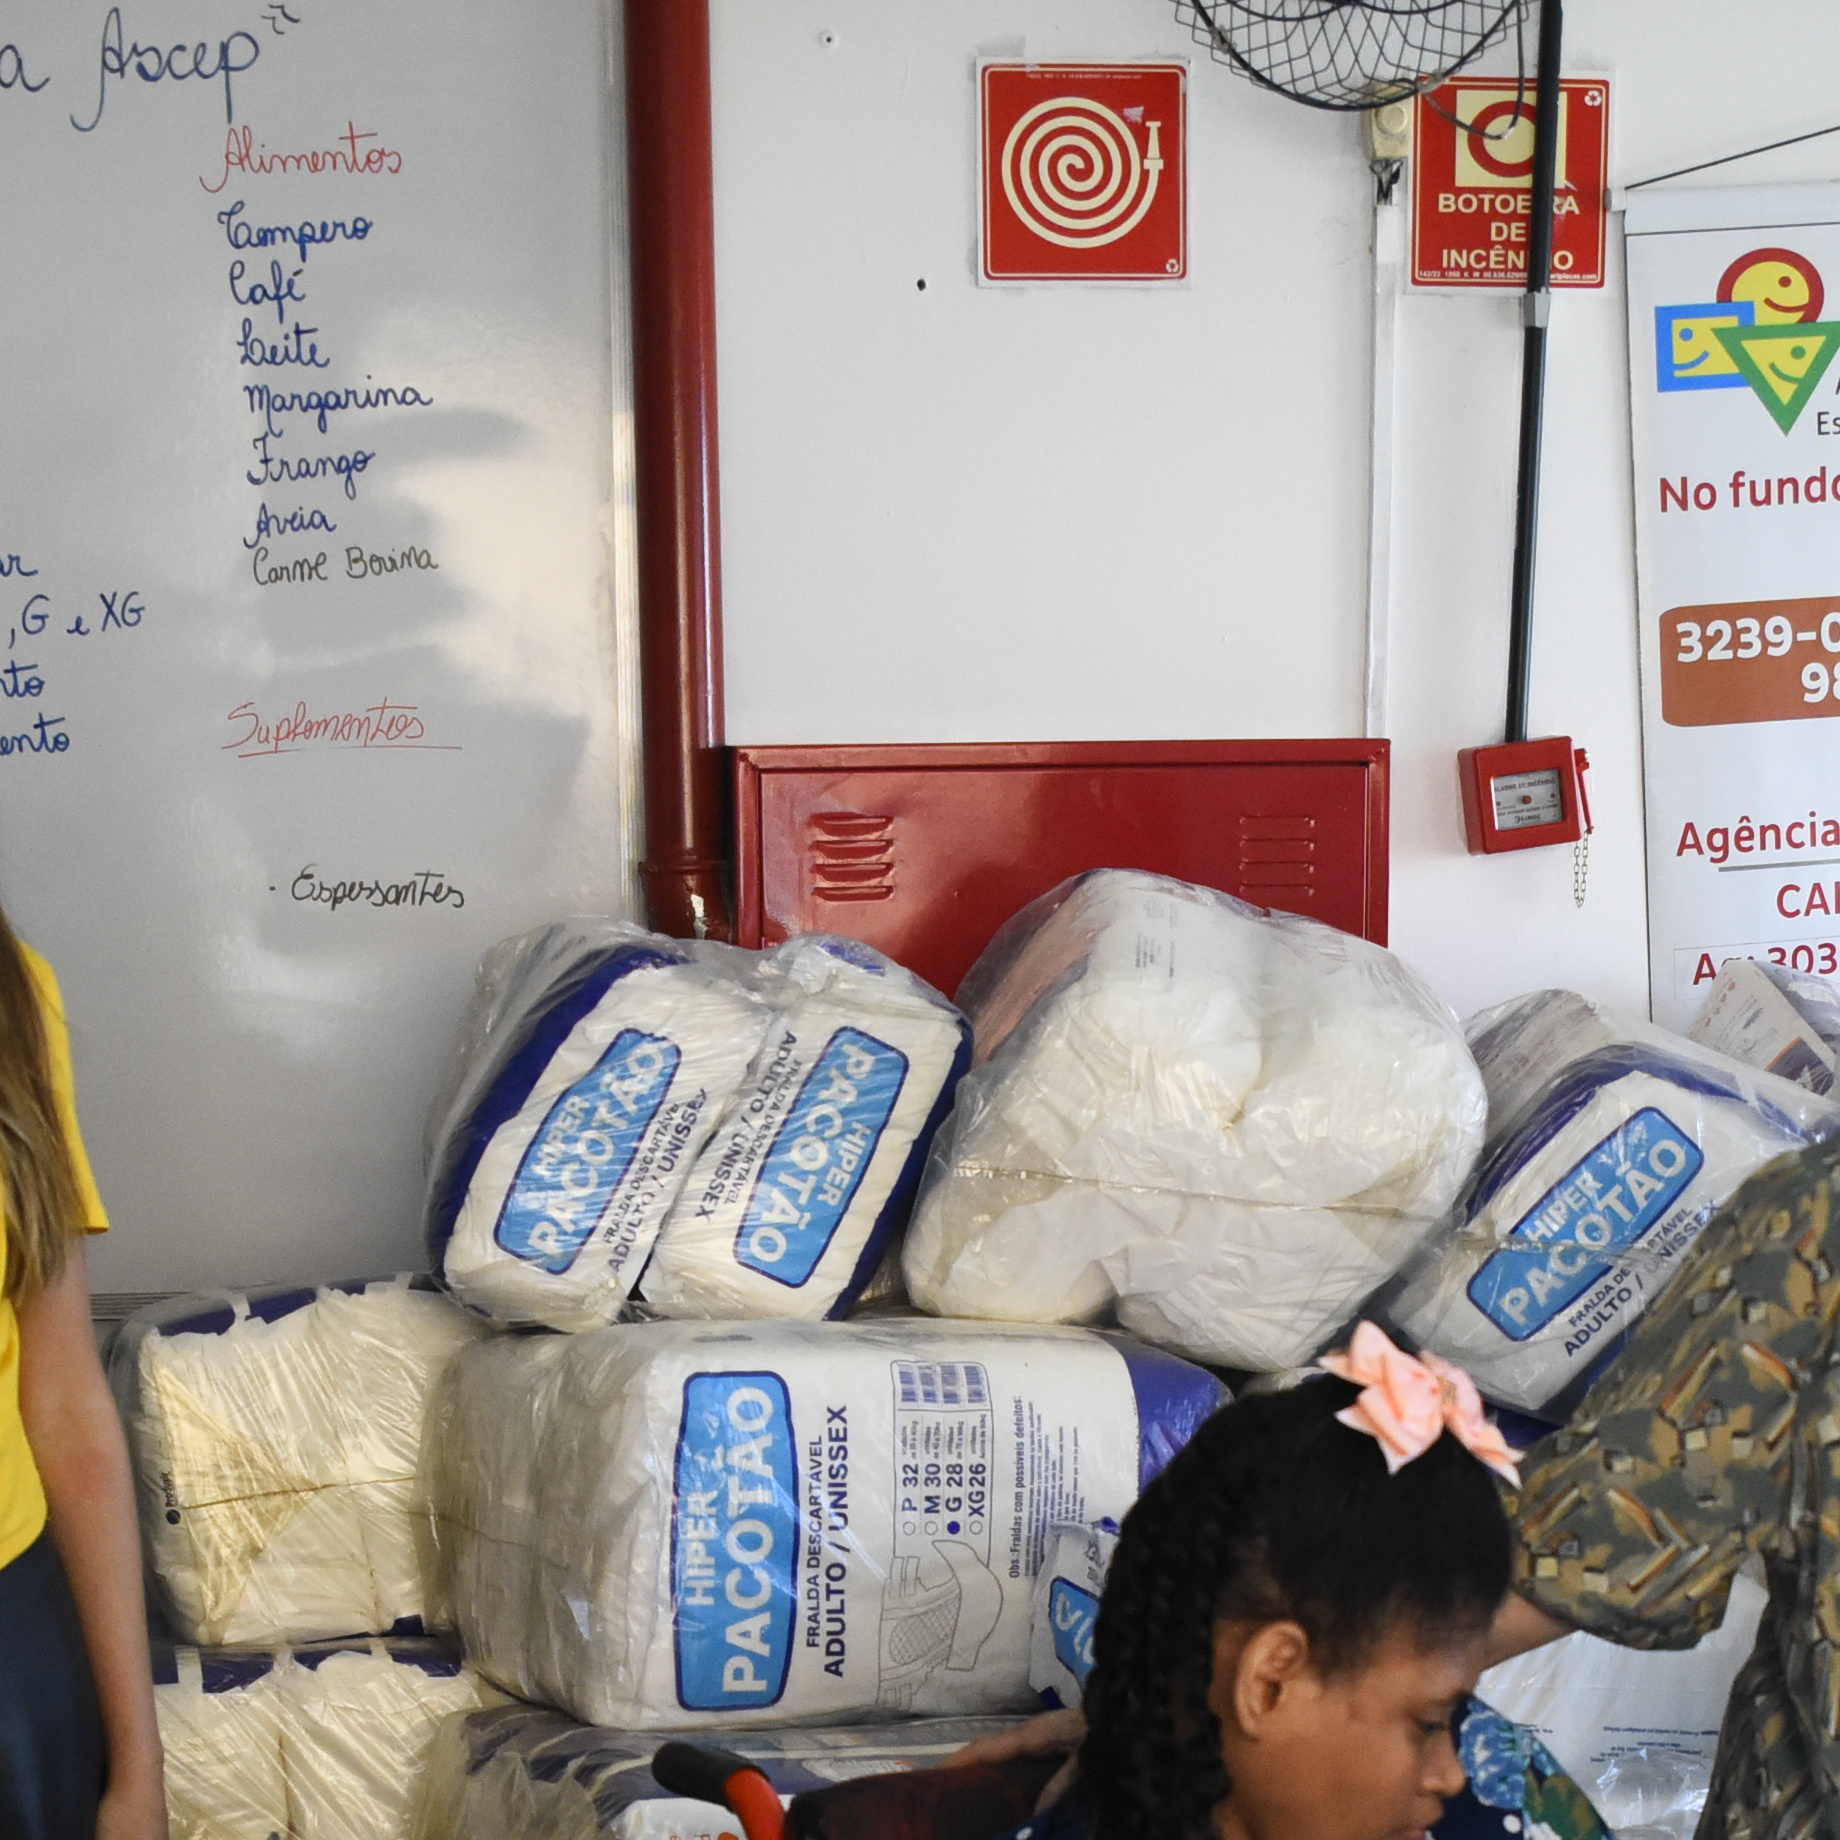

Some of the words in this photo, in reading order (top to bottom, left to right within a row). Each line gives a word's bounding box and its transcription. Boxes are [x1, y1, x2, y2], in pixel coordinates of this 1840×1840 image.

[199, 121, 402, 194] Alimentos
[218, 200, 374, 263] Tempero
[1442, 245, 1574, 270] INCÊNO
[1490, 222, 1526, 241] DE
[229, 259, 306, 324] Café
[237, 317, 330, 369] Leite
[243, 374, 433, 438] Margarina
[247, 431, 375, 500] Frango
[1660, 476, 1717, 512] No
[243, 502, 337, 549] Aveia
[253, 545, 328, 586] Carne
[346, 544, 439, 580] Bovina
[23, 592, 50, 632] G
[100, 590, 146, 631] XG
[221, 695, 425, 754] Suplementos
[1677, 811, 1840, 863] Agência
[291, 863, 465, 911] Espessantes
[748, 1030, 798, 1116] ADULTO
[527, 1042, 668, 1261] PACOTÃO
[531, 1094, 591, 1178] HIPER
[748, 1041, 875, 1263] PACOTÃO
[817, 1121, 873, 1207] HIPER
[609, 1191, 657, 1271] ADULTO
[658, 1086, 709, 1176] UNISSEX
[695, 1129, 744, 1225] UNISSEX
[602, 1193, 632, 1245] FRALDA
[1501, 1138, 1688, 1327] PACOTÃO
[1523, 1167, 1601, 1254] HIPER
[1563, 1288, 1634, 1359] ADULTO
[1568, 1284, 1612, 1329] FRALDA
[826, 1404, 849, 1539] UNISSEX
[902, 1463, 919, 1488] 32
[923, 1463, 941, 1488] 30
[945, 1463, 964, 1488] 28
[968, 1463, 986, 1488] 26
[1013, 1441, 1026, 1489] possíveis
[807, 1434, 825, 1563] DESCARTÁVEL
[901, 1497, 918, 1513] P
[923, 1495, 941, 1515] M
[945, 1496, 962, 1513] G
[967, 1490, 986, 1518] XG
[1013, 1491, 1023, 1513] com
[682, 1490, 719, 1608] HIPER
[717, 1384, 775, 1696] PACOTÃO
[804, 1566, 822, 1649] FRALDA
[823, 1559, 848, 1679] ADULTO
